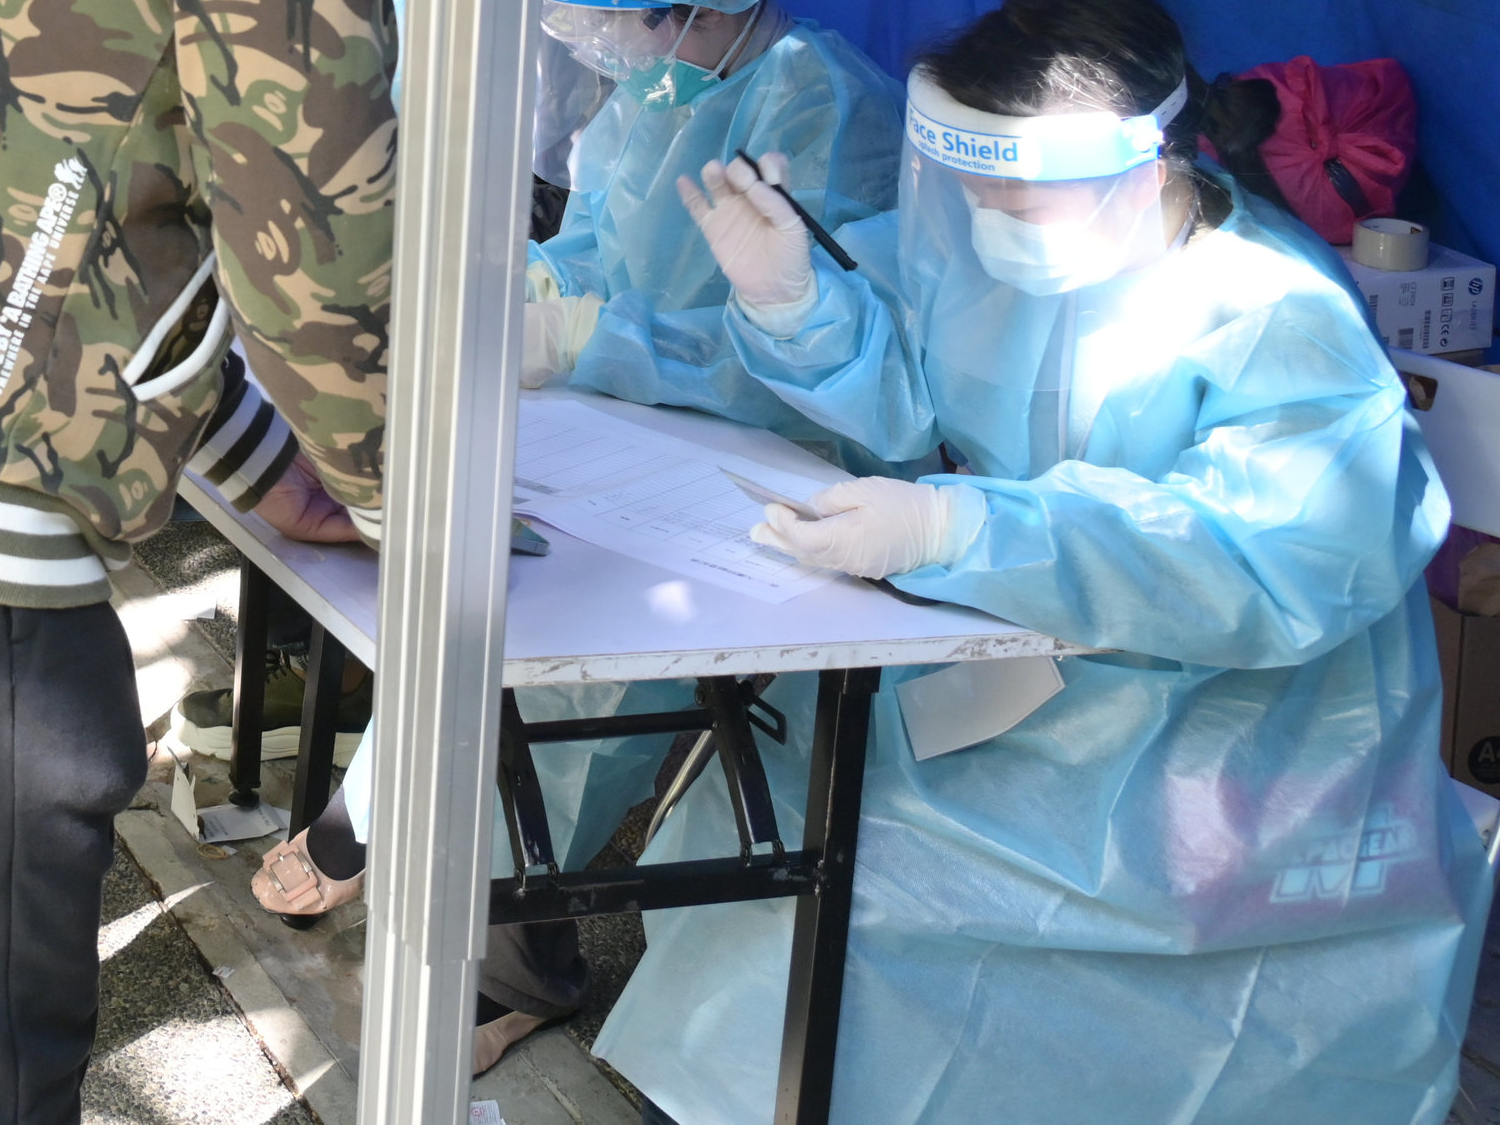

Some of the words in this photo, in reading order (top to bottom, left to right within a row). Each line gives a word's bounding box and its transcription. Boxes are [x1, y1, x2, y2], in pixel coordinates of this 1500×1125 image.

[942, 131, 1018, 162] Shield
[942, 153, 995, 172] protection
[18, 313, 32, 328] IN
[25, 287, 42, 309] THE
[49, 191, 79, 250] UNIVERSE
